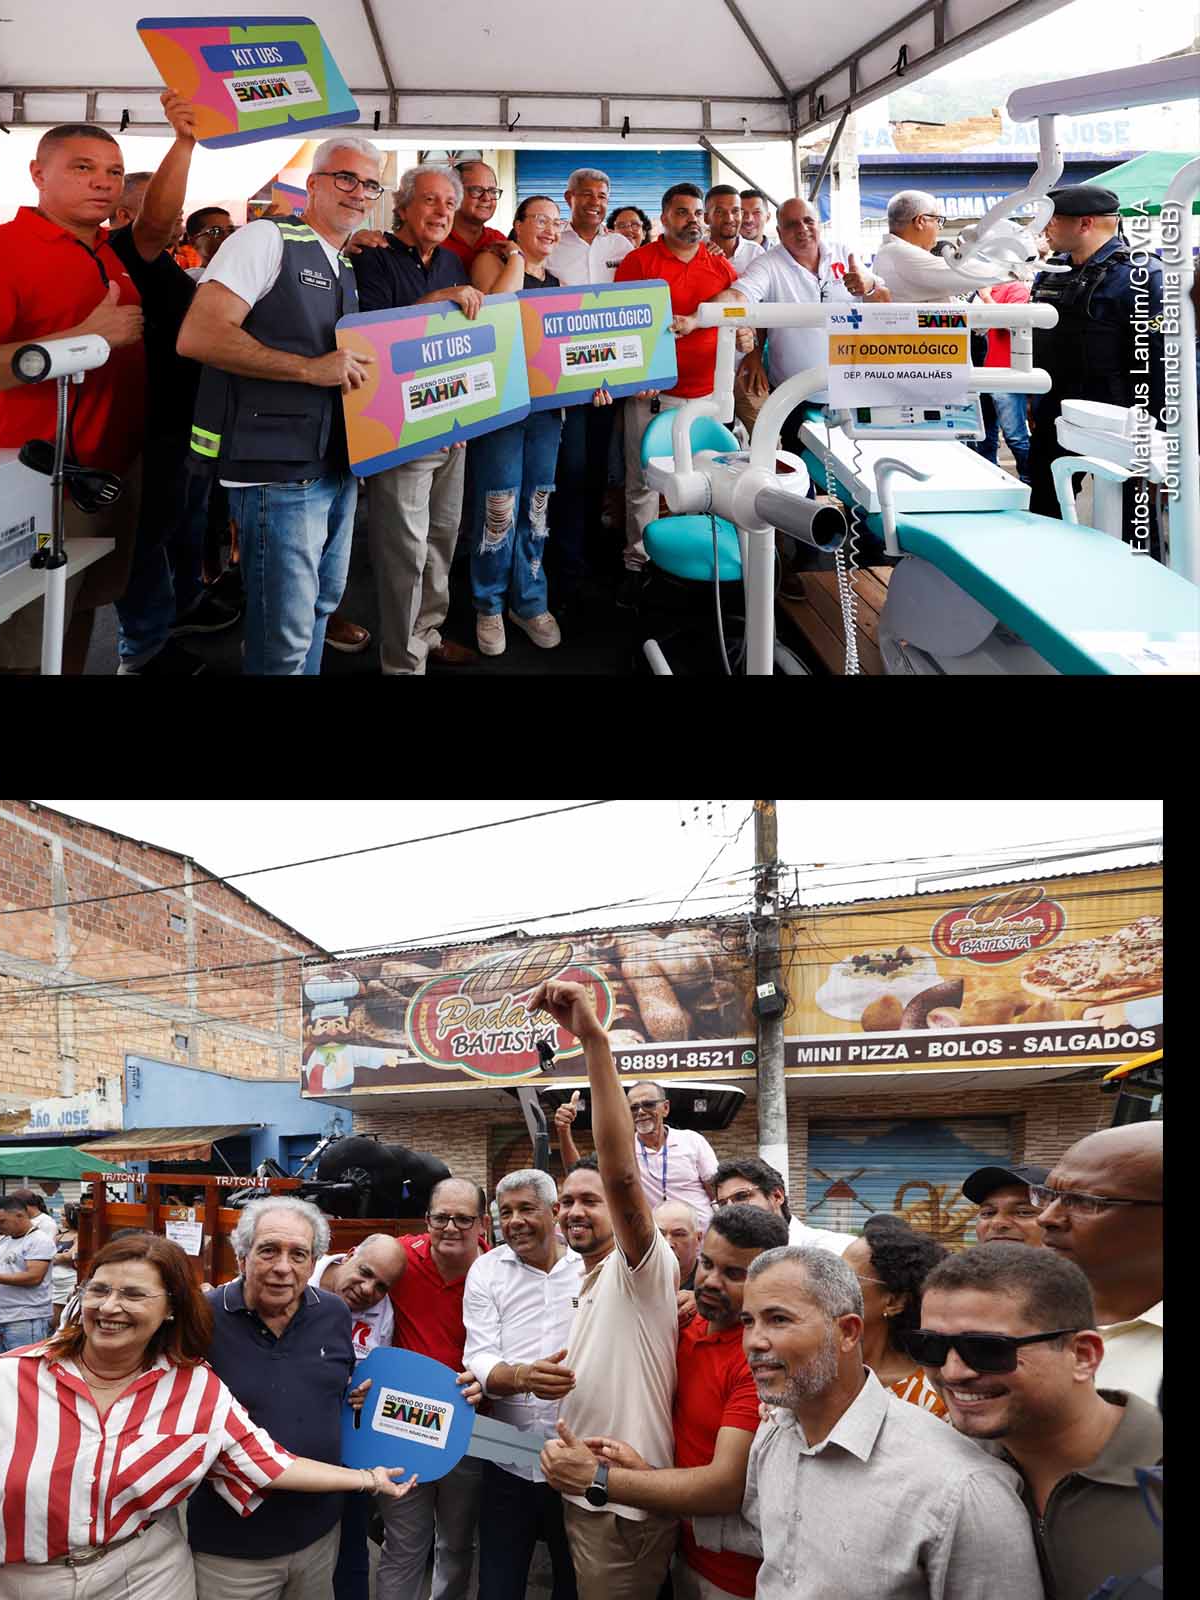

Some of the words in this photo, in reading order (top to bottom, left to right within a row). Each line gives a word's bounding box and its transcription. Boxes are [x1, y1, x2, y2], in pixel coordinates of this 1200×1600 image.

[231, 48, 255, 66] KIT
[256, 47, 283, 64] UBS
[235, 82, 293, 102] BAHIA
[544, 315, 563, 335] KIT
[568, 308, 651, 333] ODONTOLÓGICO
[831, 315, 847, 324] SUS
[918, 314, 967, 328] BAHIA
[421, 340, 446, 364] KIT
[447, 334, 472, 358] UBS
[566, 347, 616, 366] BAHIA
[838, 344, 856, 355] KIT
[859, 341, 958, 355] ODONTOLÓGICO
[864, 371, 894, 379] PAULO
[896, 369, 953, 379] MAGALHÃES
[409, 379, 469, 410] BAHIA
[960, 935, 1031, 954] BATISTA
[797, 1046, 841, 1063] MINI
[848, 1043, 909, 1061] PIZZA
[928, 1038, 1002, 1058] BOLOS
[1023, 1030, 1156, 1053] SALGADOS
[620, 1051, 734, 1071] 98891-8521
[216, 1176, 256, 1186] TRITON
[385, 1393, 414, 1406] GOVERNO
[382, 1400, 442, 1431] BAHIA
